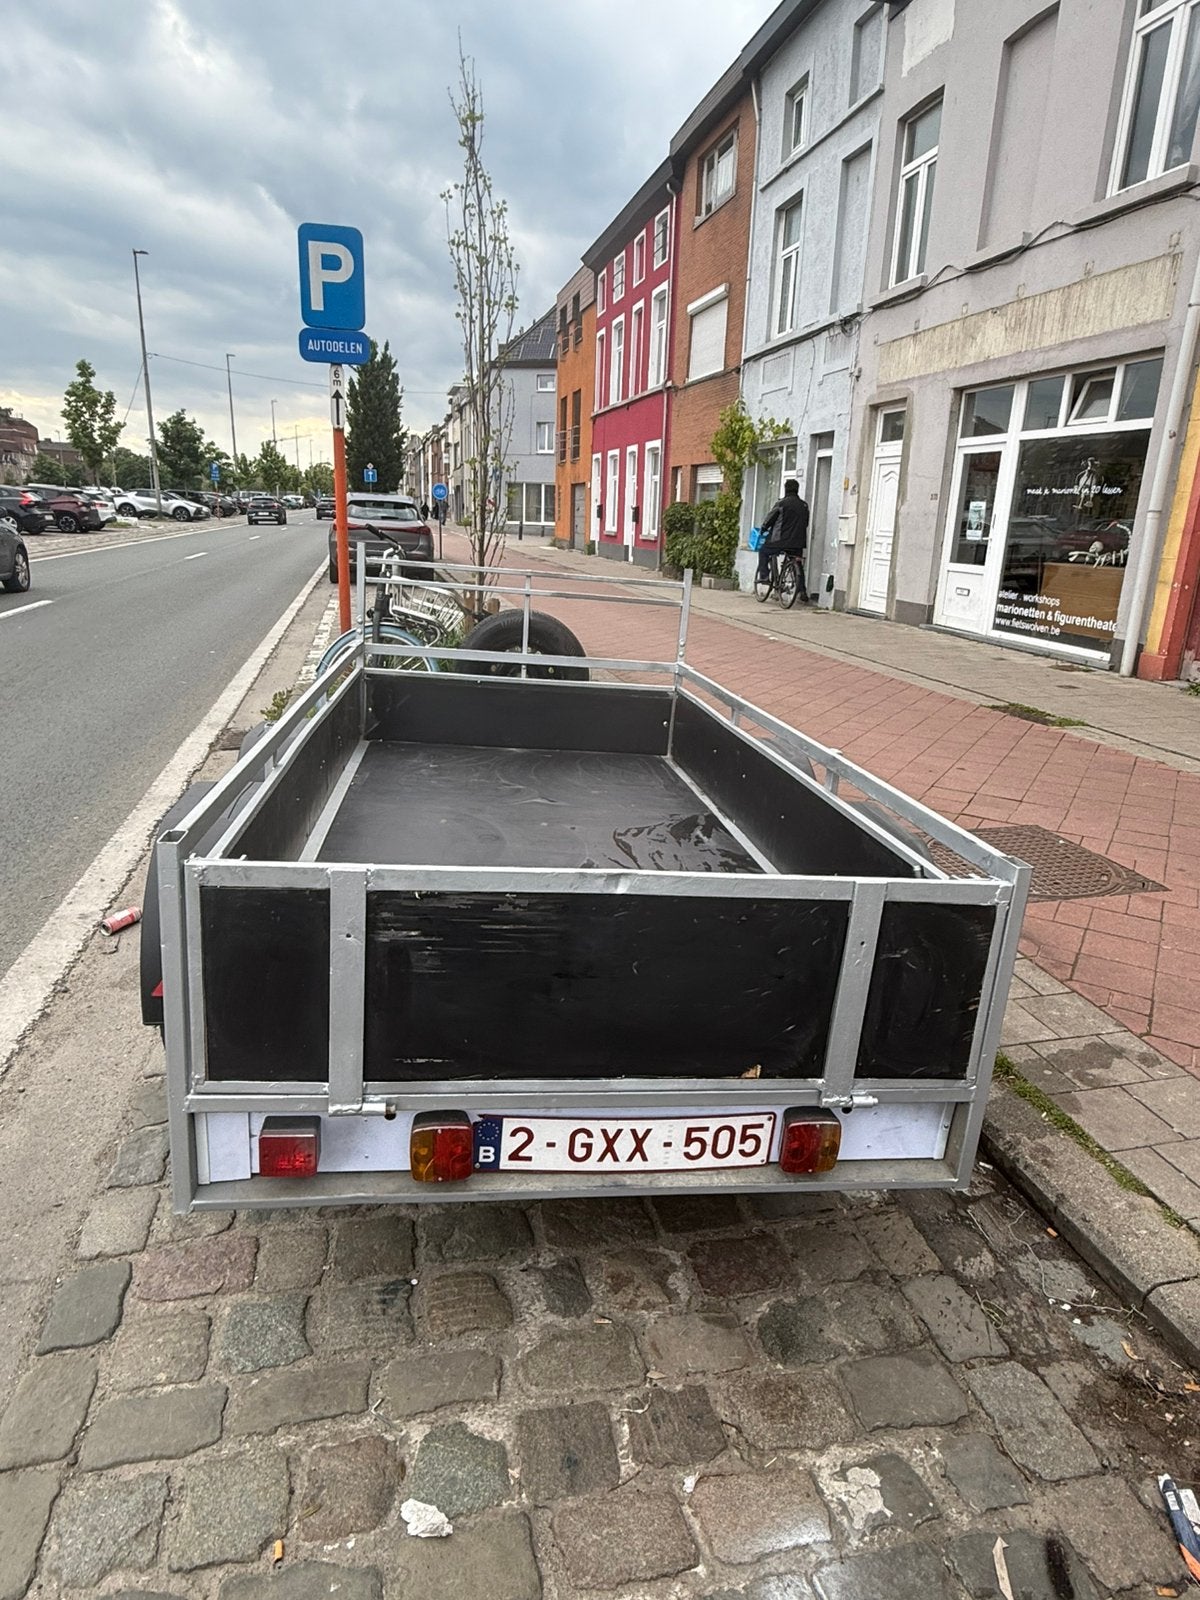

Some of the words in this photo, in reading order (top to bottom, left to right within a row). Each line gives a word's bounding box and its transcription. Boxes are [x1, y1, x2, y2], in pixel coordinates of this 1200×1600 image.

[308, 240, 354, 311] P
[307, 339, 363, 354] AUTODELEN
[333, 367, 340, 379] 6
[1091, 485, 1101, 494] 20
[998, 589, 1019, 601] atelier
[1023, 593, 1061, 607] workshops
[996, 603, 1046, 620] marionetten
[1046, 611, 1053, 621] &
[479, 1146, 496, 1163] B
